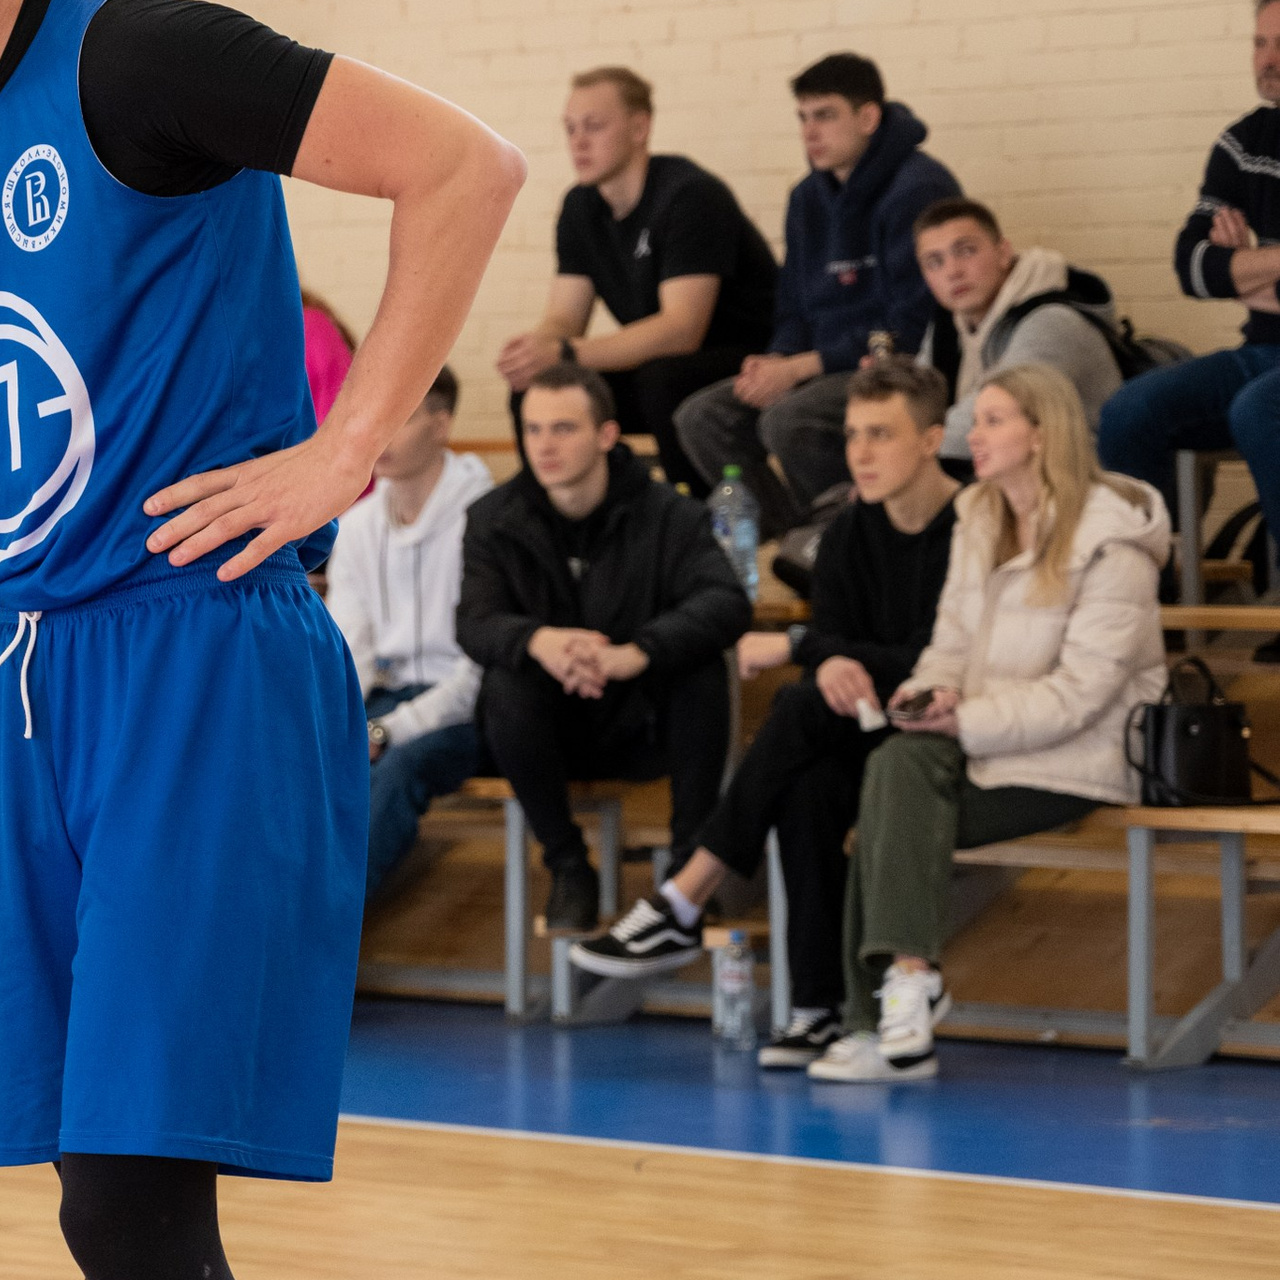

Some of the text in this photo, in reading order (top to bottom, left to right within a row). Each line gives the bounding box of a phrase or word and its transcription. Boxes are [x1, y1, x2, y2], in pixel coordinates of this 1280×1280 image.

[4, 148, 67, 249] ВЫСШАЯ ШКОЛА ЭКОНОМИКИ
